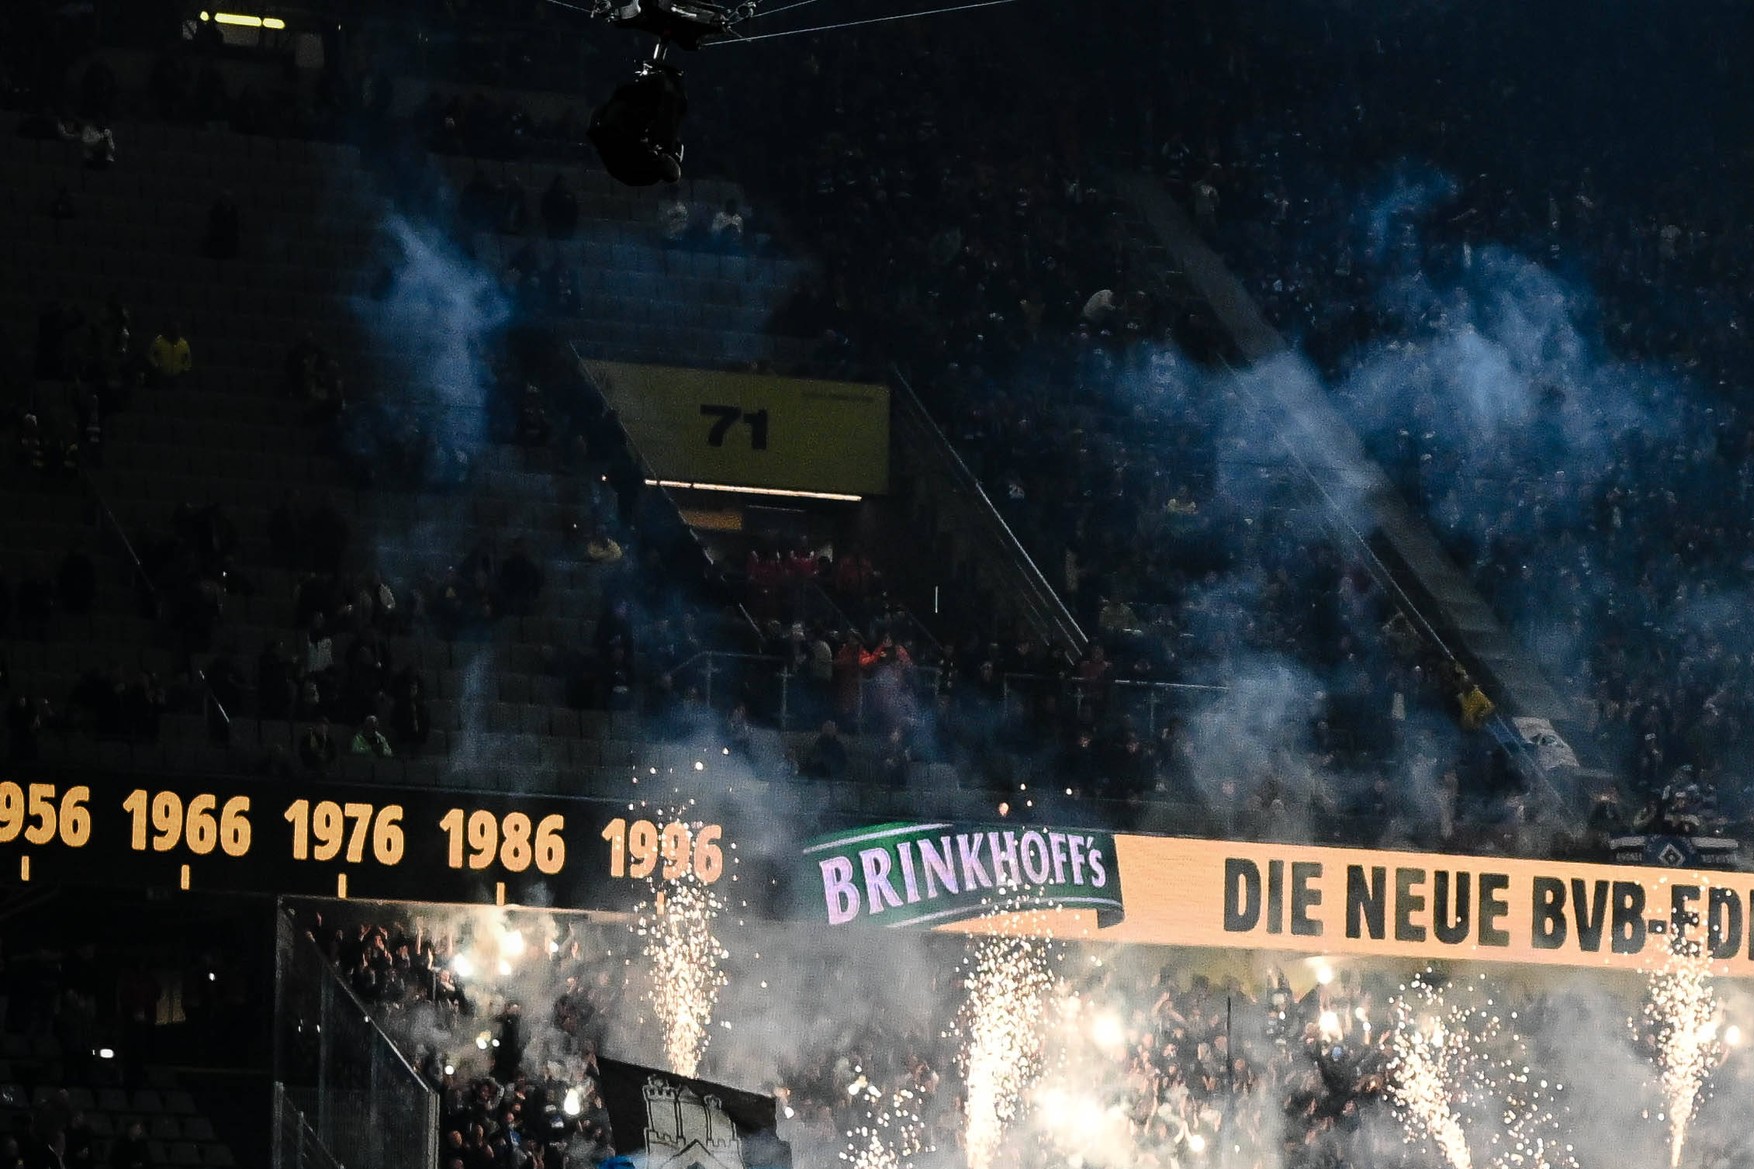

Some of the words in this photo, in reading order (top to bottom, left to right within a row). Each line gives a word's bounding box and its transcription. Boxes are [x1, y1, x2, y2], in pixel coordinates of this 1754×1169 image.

[700, 404, 768, 449] 71
[123, 789, 251, 857] 1966
[285, 799, 404, 866] 1976
[440, 809, 566, 874] 1986
[602, 818, 723, 884] 1996
[1224, 857, 1323, 936] DIE
[1346, 864, 1509, 948] NEUE
